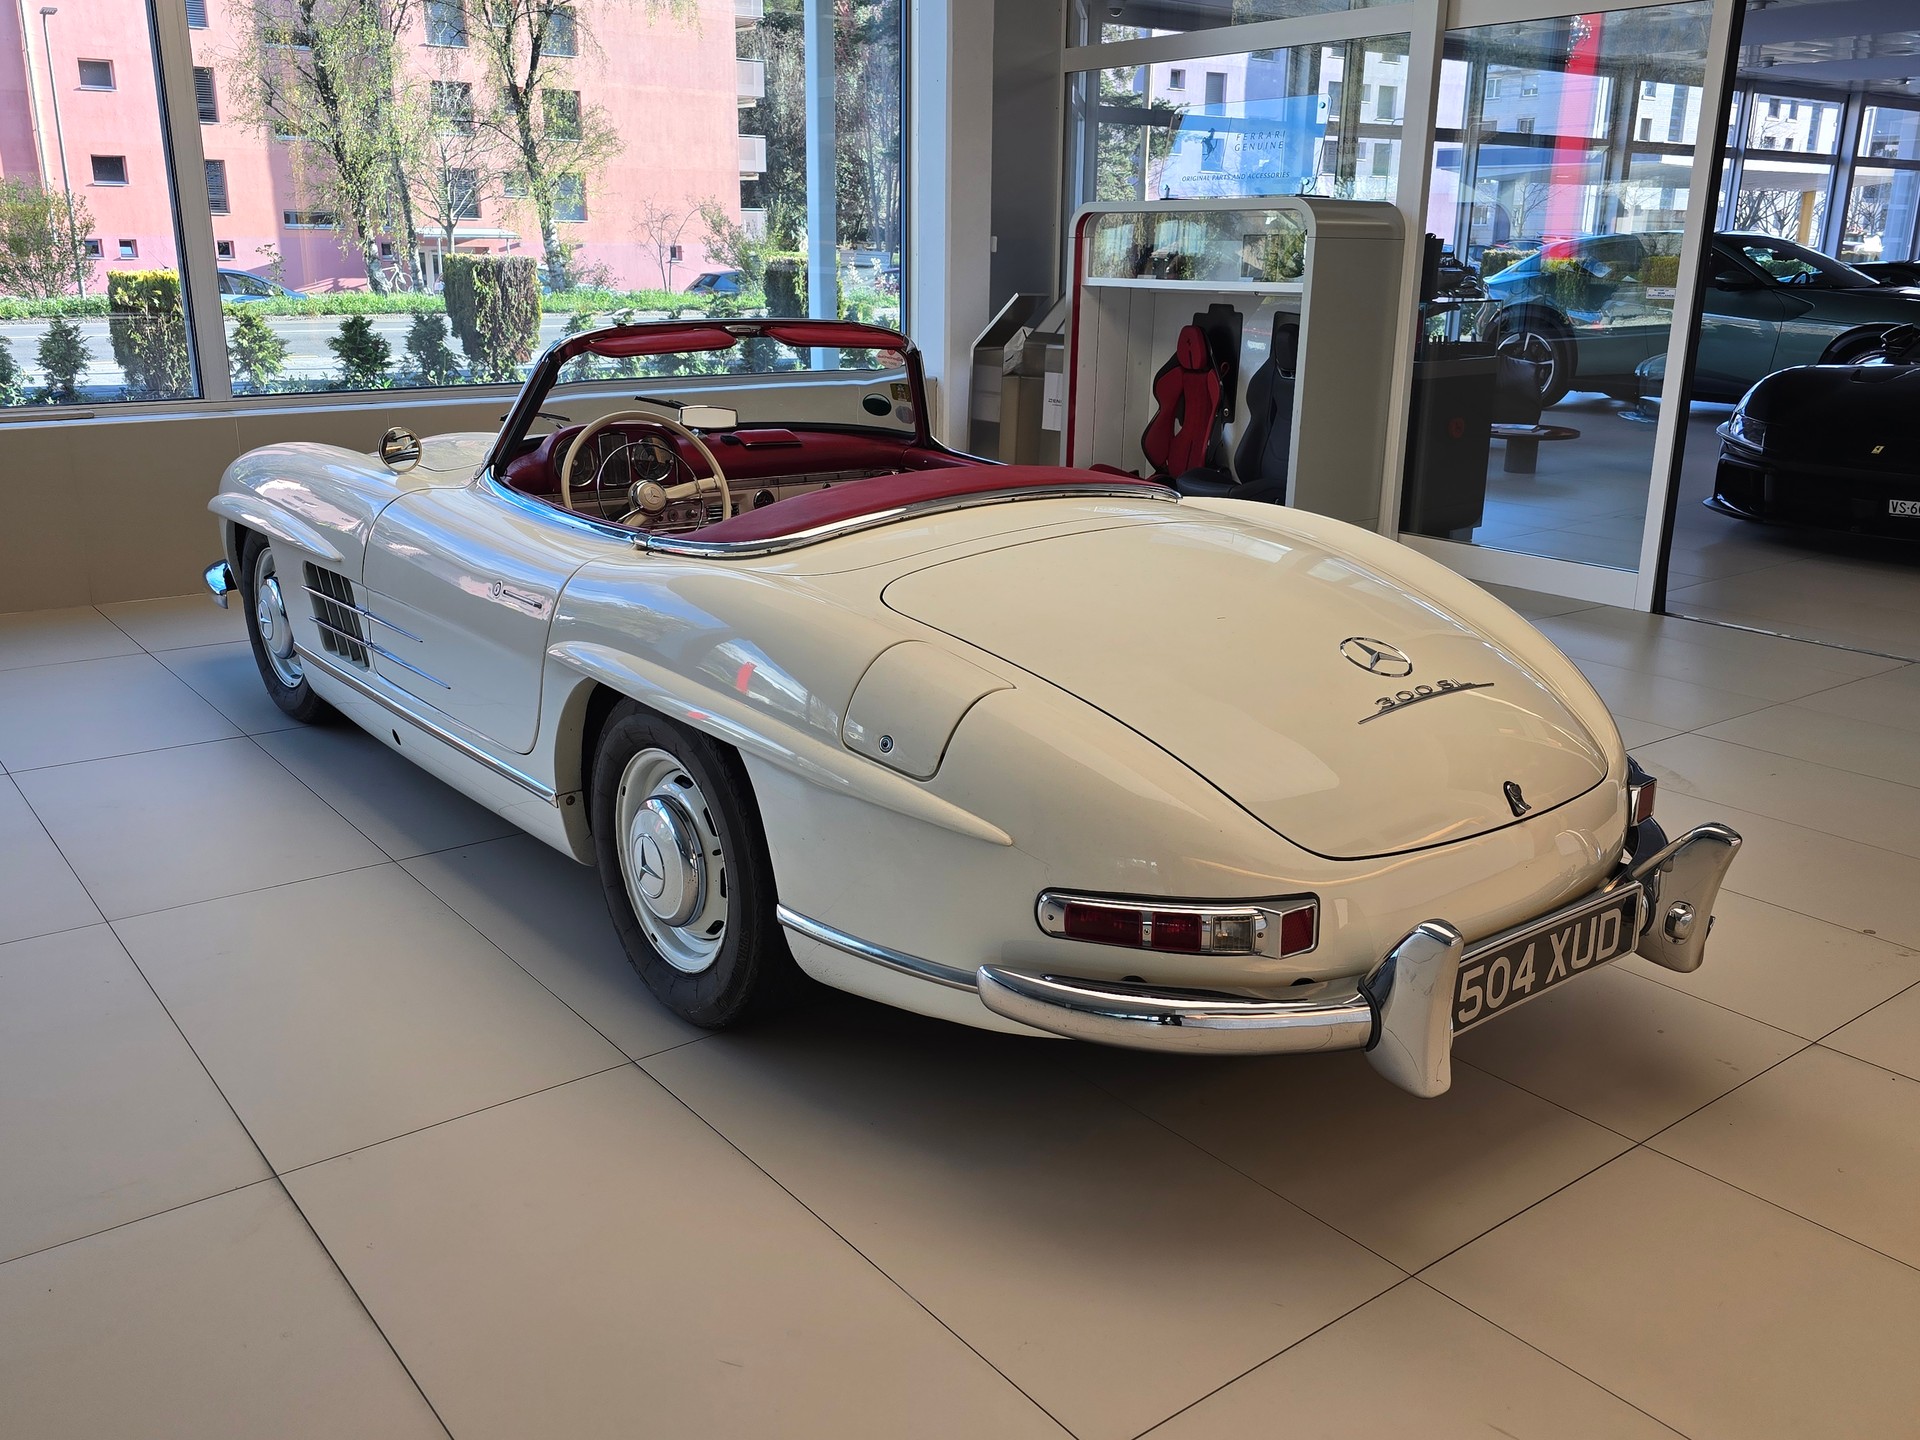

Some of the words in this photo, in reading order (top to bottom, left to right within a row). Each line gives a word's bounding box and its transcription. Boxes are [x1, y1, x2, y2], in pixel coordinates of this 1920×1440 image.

[1236, 130, 1286, 141] FERRARI
[1234, 141, 1284, 152] GENUINE
[1248, 172, 1290, 180] ACCESSORIES
[1374, 685, 1433, 709] 300
[1458, 942, 1536, 1023] 504
[1545, 908, 1622, 984] XUD
